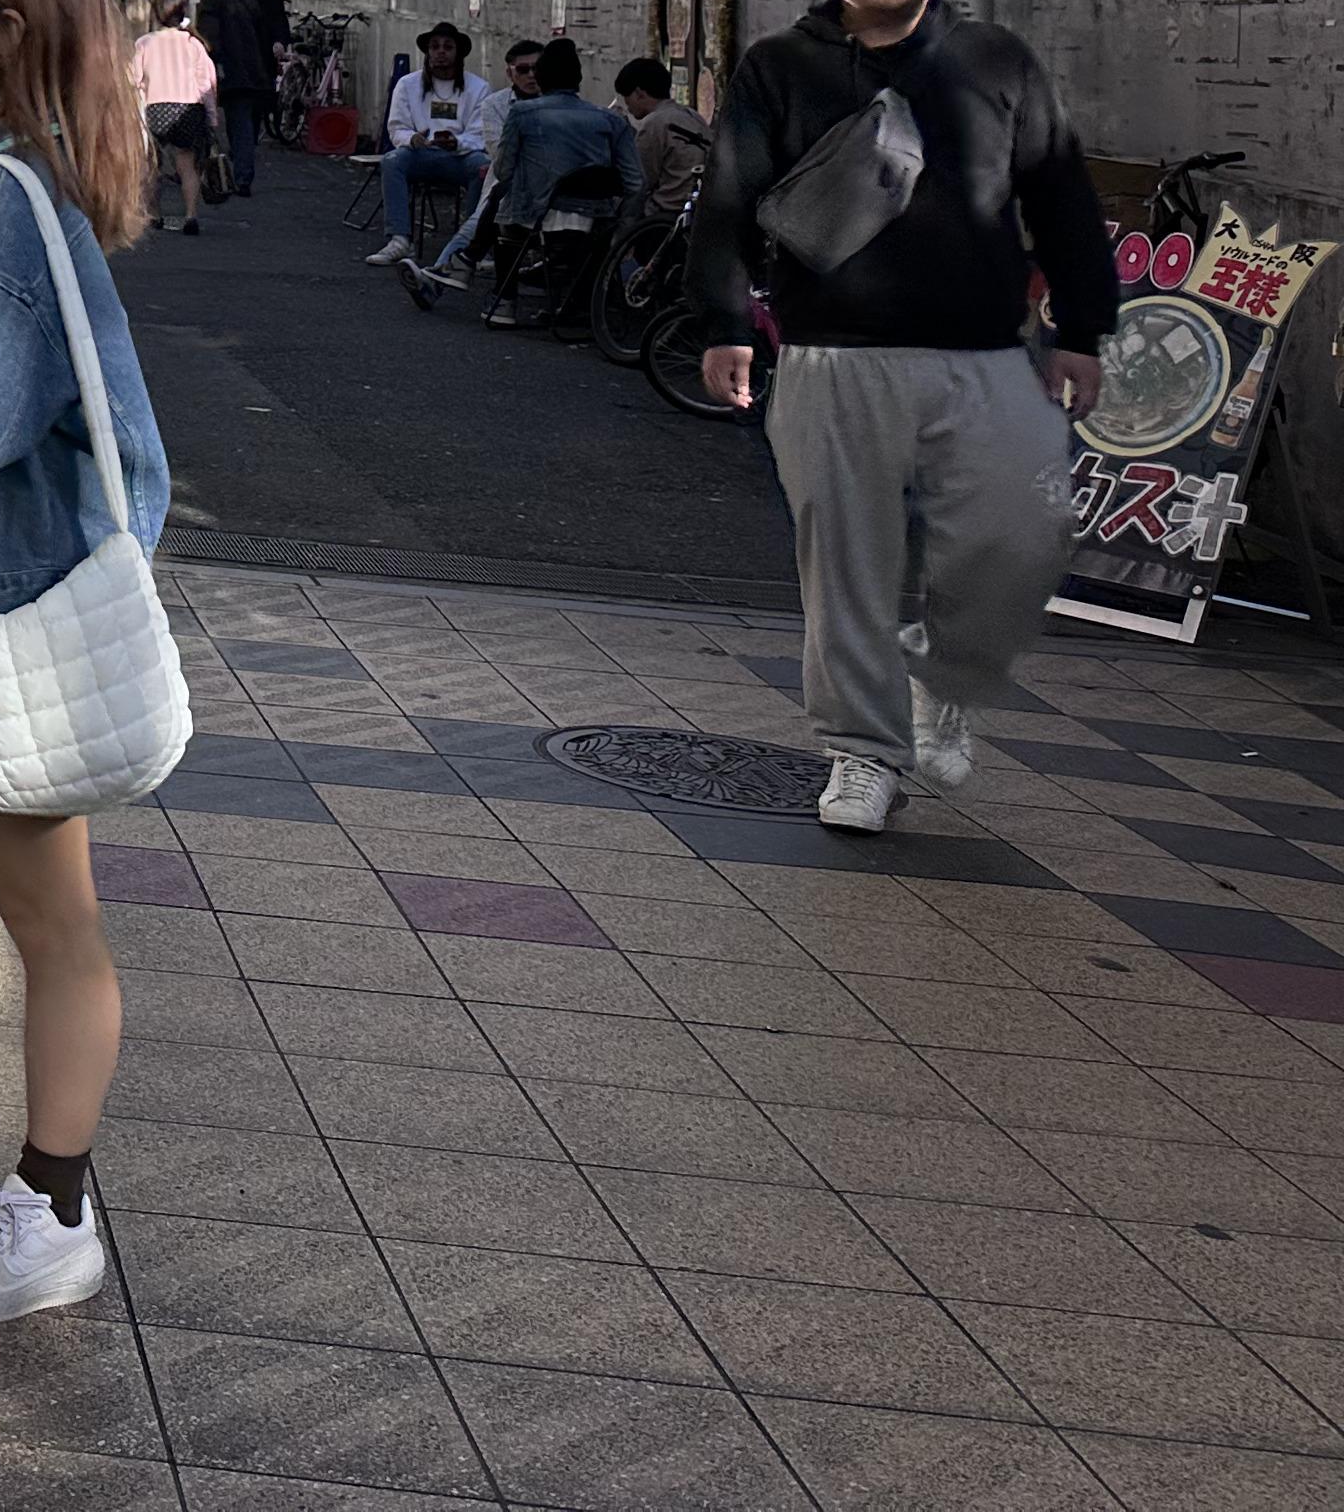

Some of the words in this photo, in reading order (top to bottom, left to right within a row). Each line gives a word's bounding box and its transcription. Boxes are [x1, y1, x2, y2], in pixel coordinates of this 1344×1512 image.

[1214, 219, 1240, 239] 大
[1221, 245, 1288, 269] ソウルフードの
[1290, 243, 1319, 267] 阪
[1198, 257, 1291, 318] 王様
